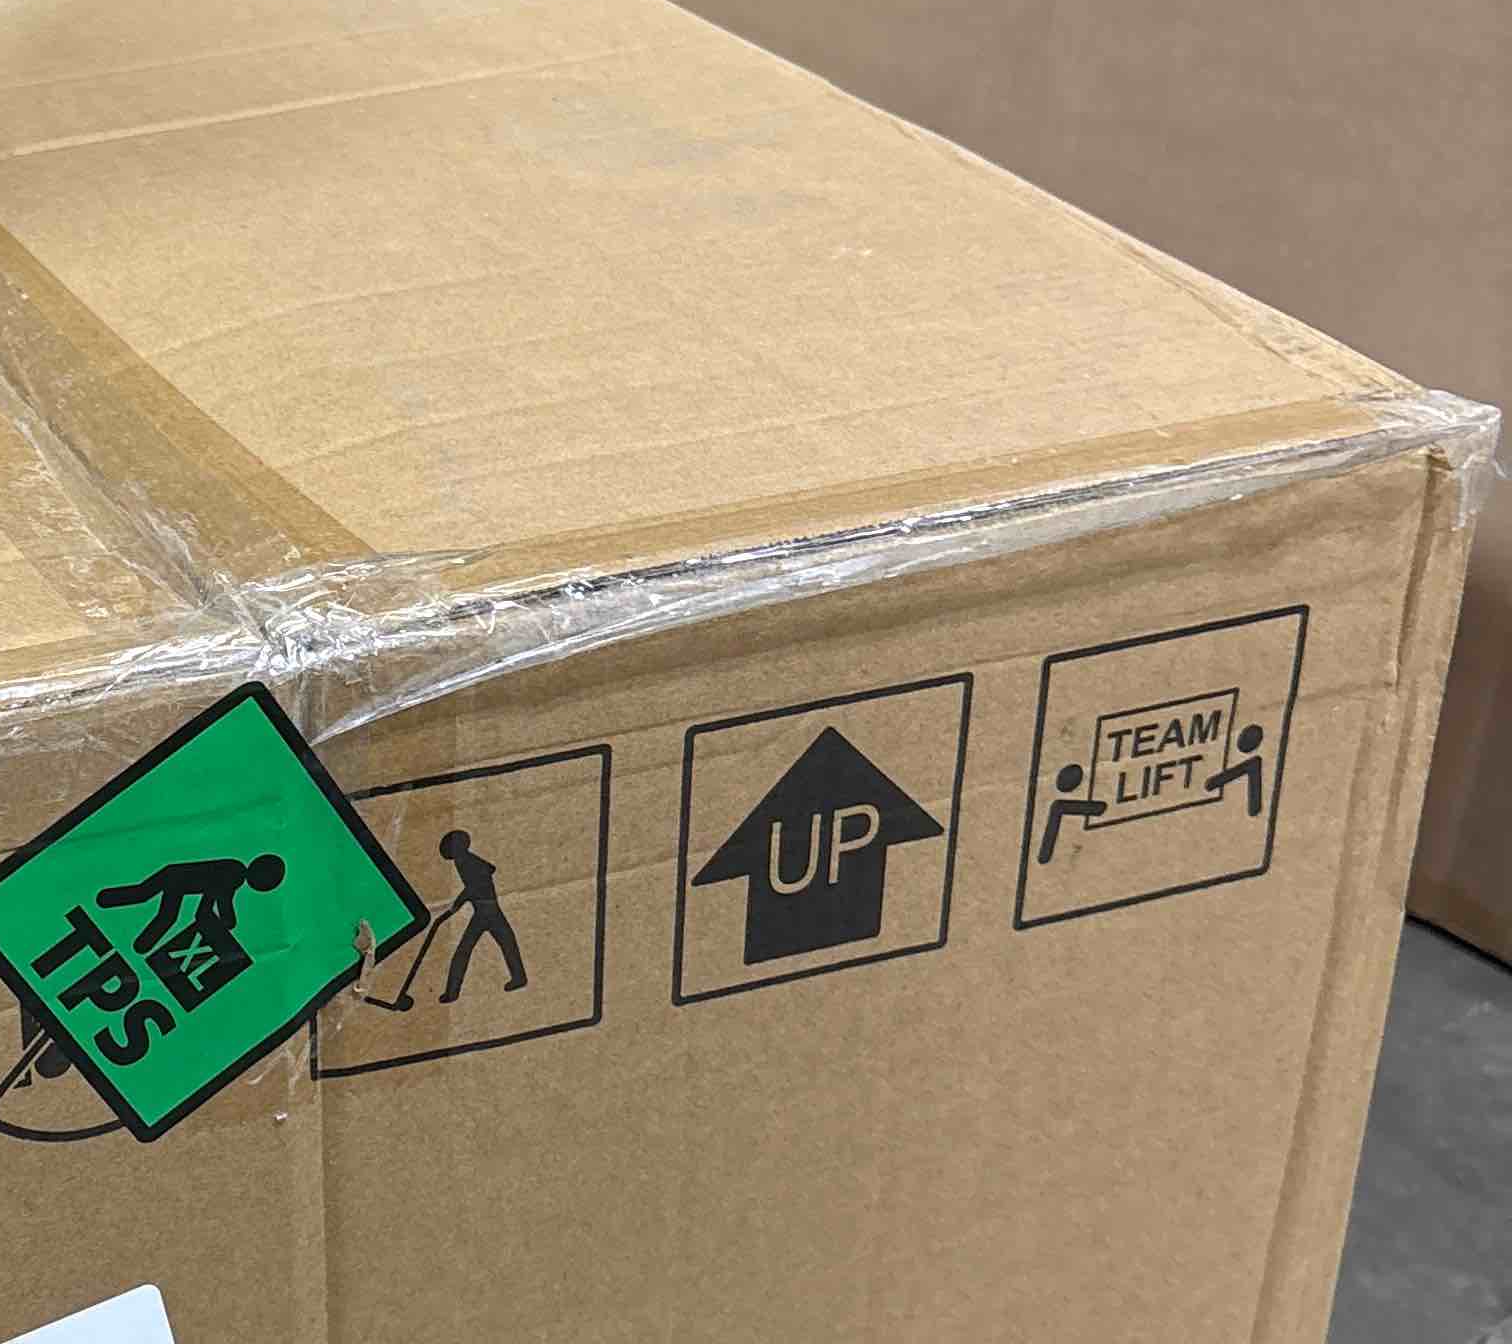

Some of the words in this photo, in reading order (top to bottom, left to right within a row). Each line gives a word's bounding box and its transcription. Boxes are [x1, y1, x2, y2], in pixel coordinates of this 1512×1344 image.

[1107, 711, 1222, 763] TEAM
[1114, 757, 1204, 803] LIFT
[767, 804, 880, 896] UP
[30, 904, 176, 1067] TPS
[168, 934, 222, 990] XL
